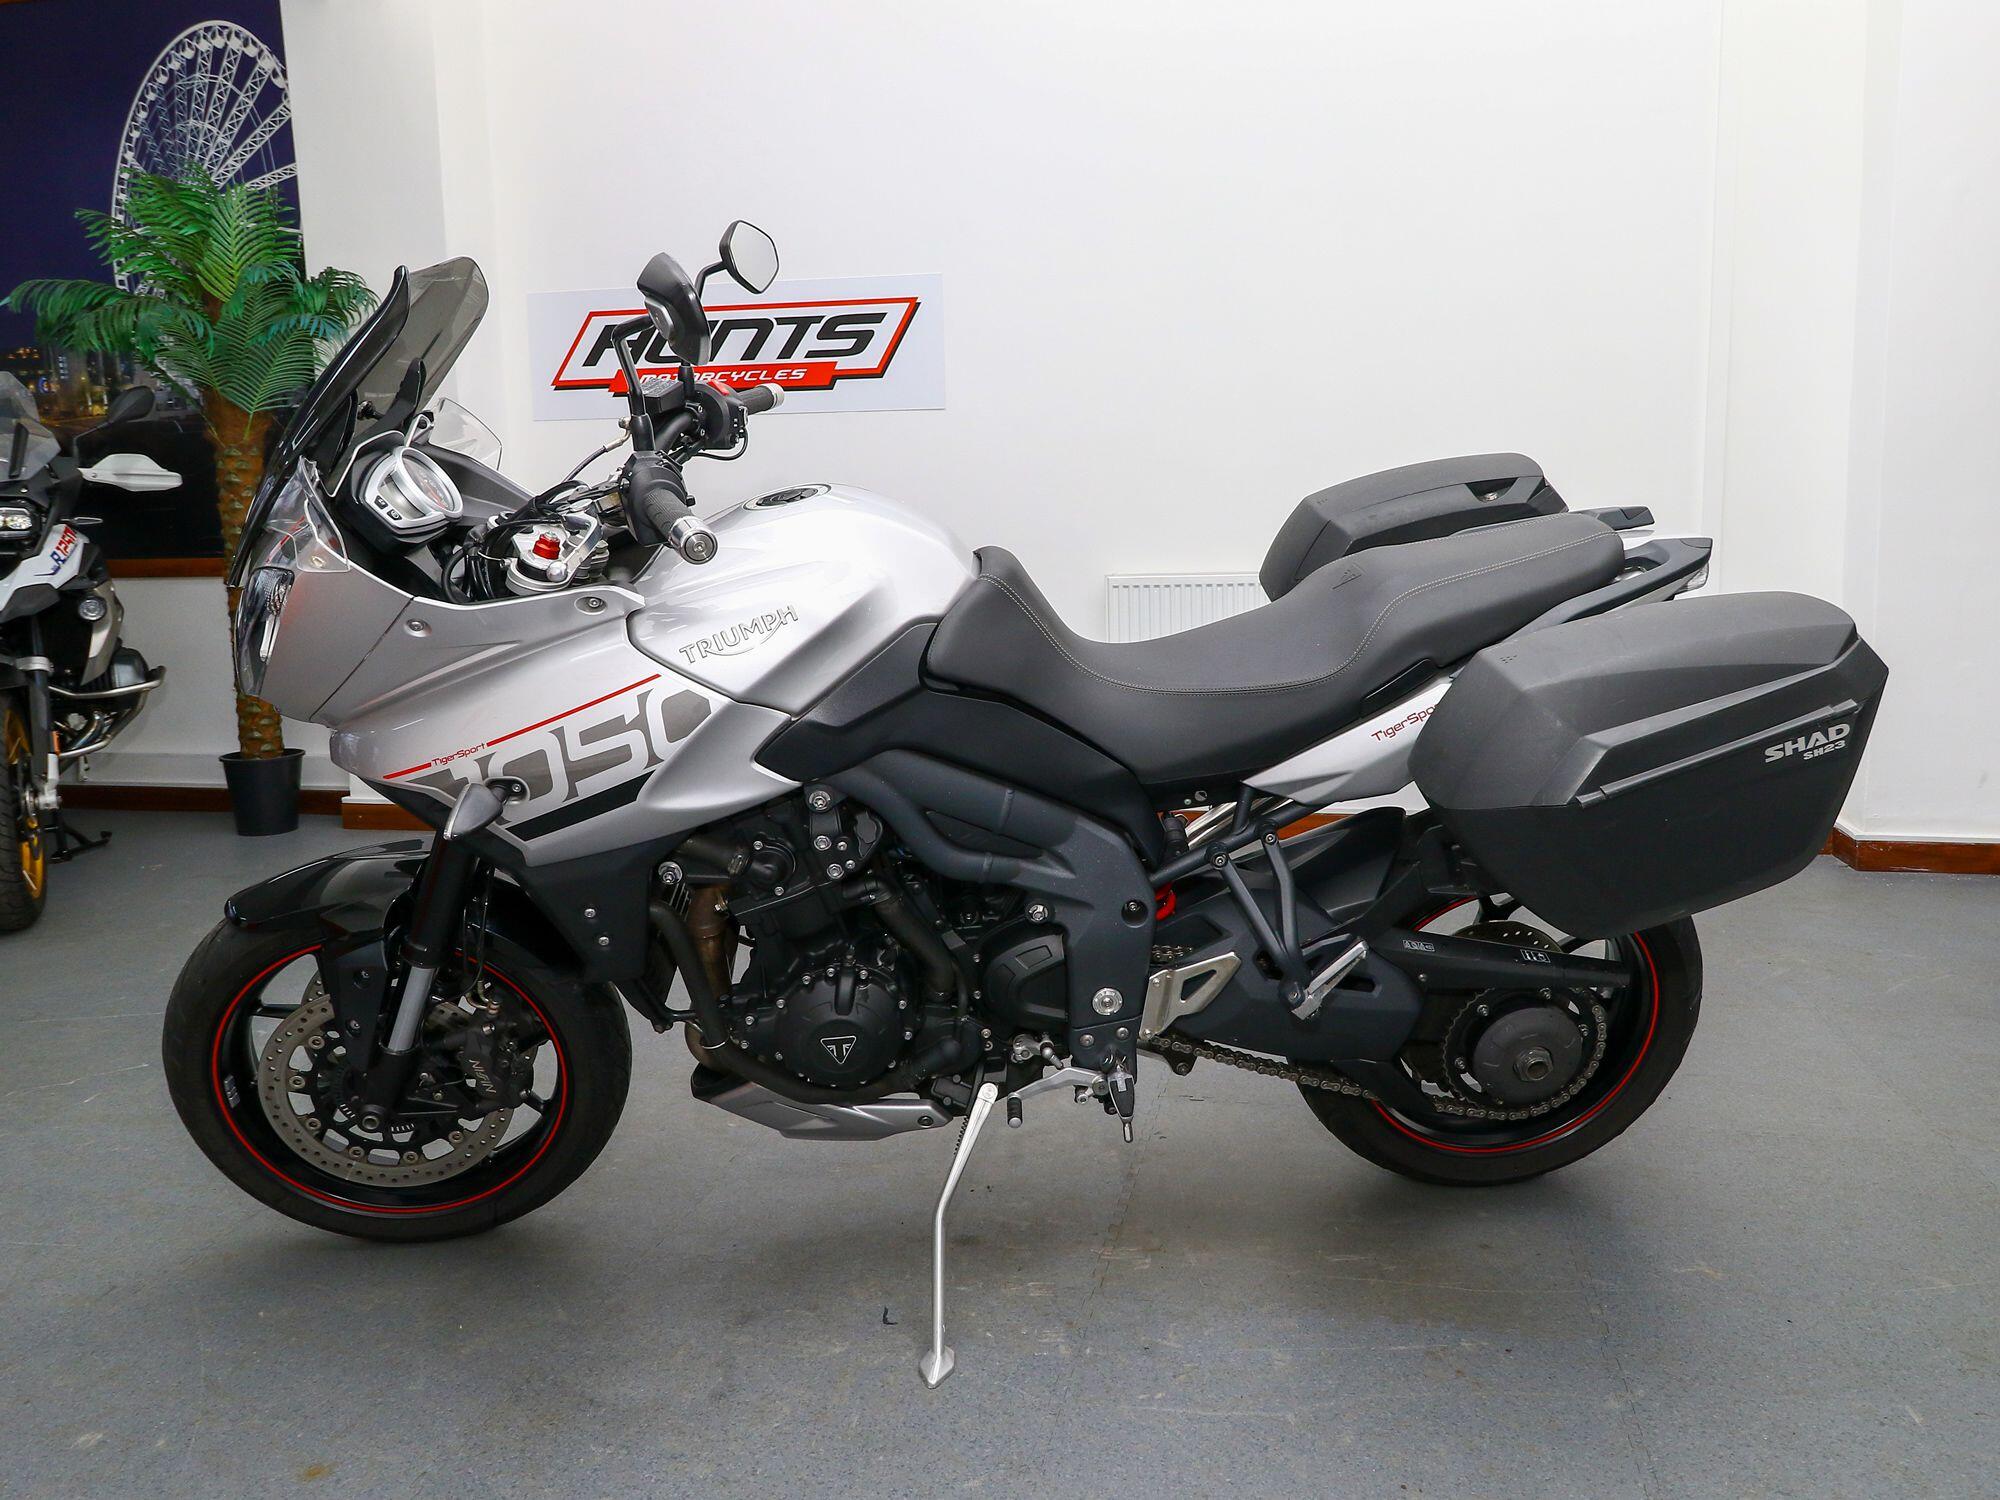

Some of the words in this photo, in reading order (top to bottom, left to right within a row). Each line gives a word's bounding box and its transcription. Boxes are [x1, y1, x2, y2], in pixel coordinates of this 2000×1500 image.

[679, 604, 798, 664] TRIUMPH
[1371, 702, 1438, 741] TigerSpo
[431, 742, 485, 766] TigerSport
[1764, 723, 1850, 763] SHAD
[1803, 740, 1846, 760] SH23
